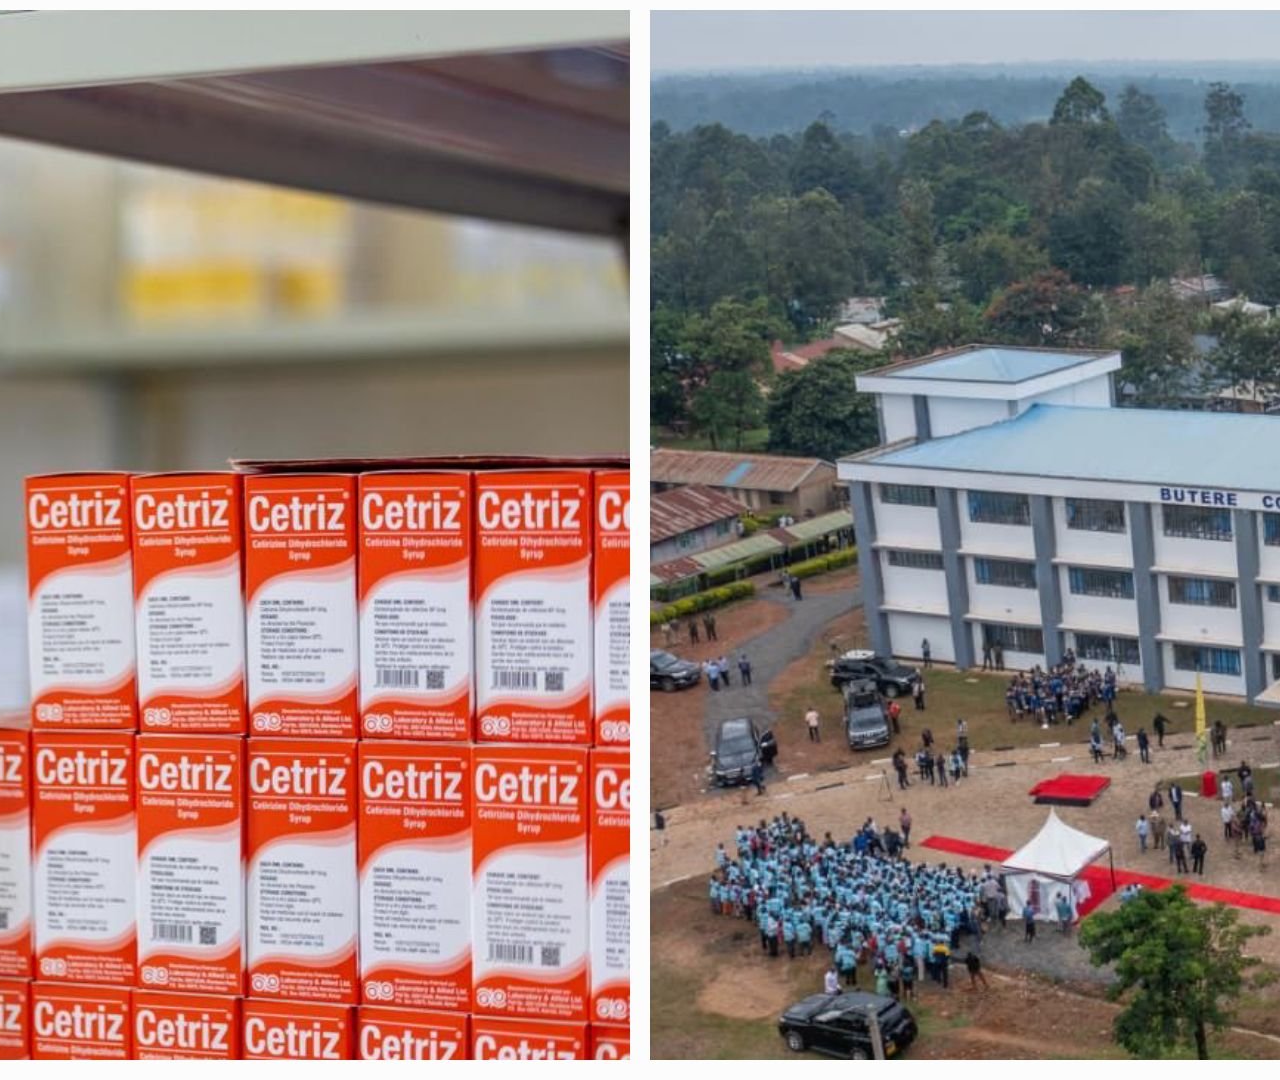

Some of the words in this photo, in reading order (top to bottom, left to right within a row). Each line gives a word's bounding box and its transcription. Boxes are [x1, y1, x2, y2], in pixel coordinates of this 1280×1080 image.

[29, 492, 122, 529] Cetriz
[135, 492, 228, 530] Cetriz
[249, 494, 344, 532] Cetriz
[362, 492, 461, 531] Cetriz
[479, 490, 580, 530] Cetriz
[1160, 488, 1238, 506] BUTERE
[36, 748, 126, 785] Cetriz
[139, 753, 232, 792] Cetriz
[250, 757, 346, 795] Cetriz
[362, 761, 463, 800] Cetriz
[475, 763, 578, 805] Cetriz
[34, 1001, 124, 1041] Cetriz
[136, 1009, 228, 1050] Cetriz
[245, 1018, 340, 1059] Cetriz
